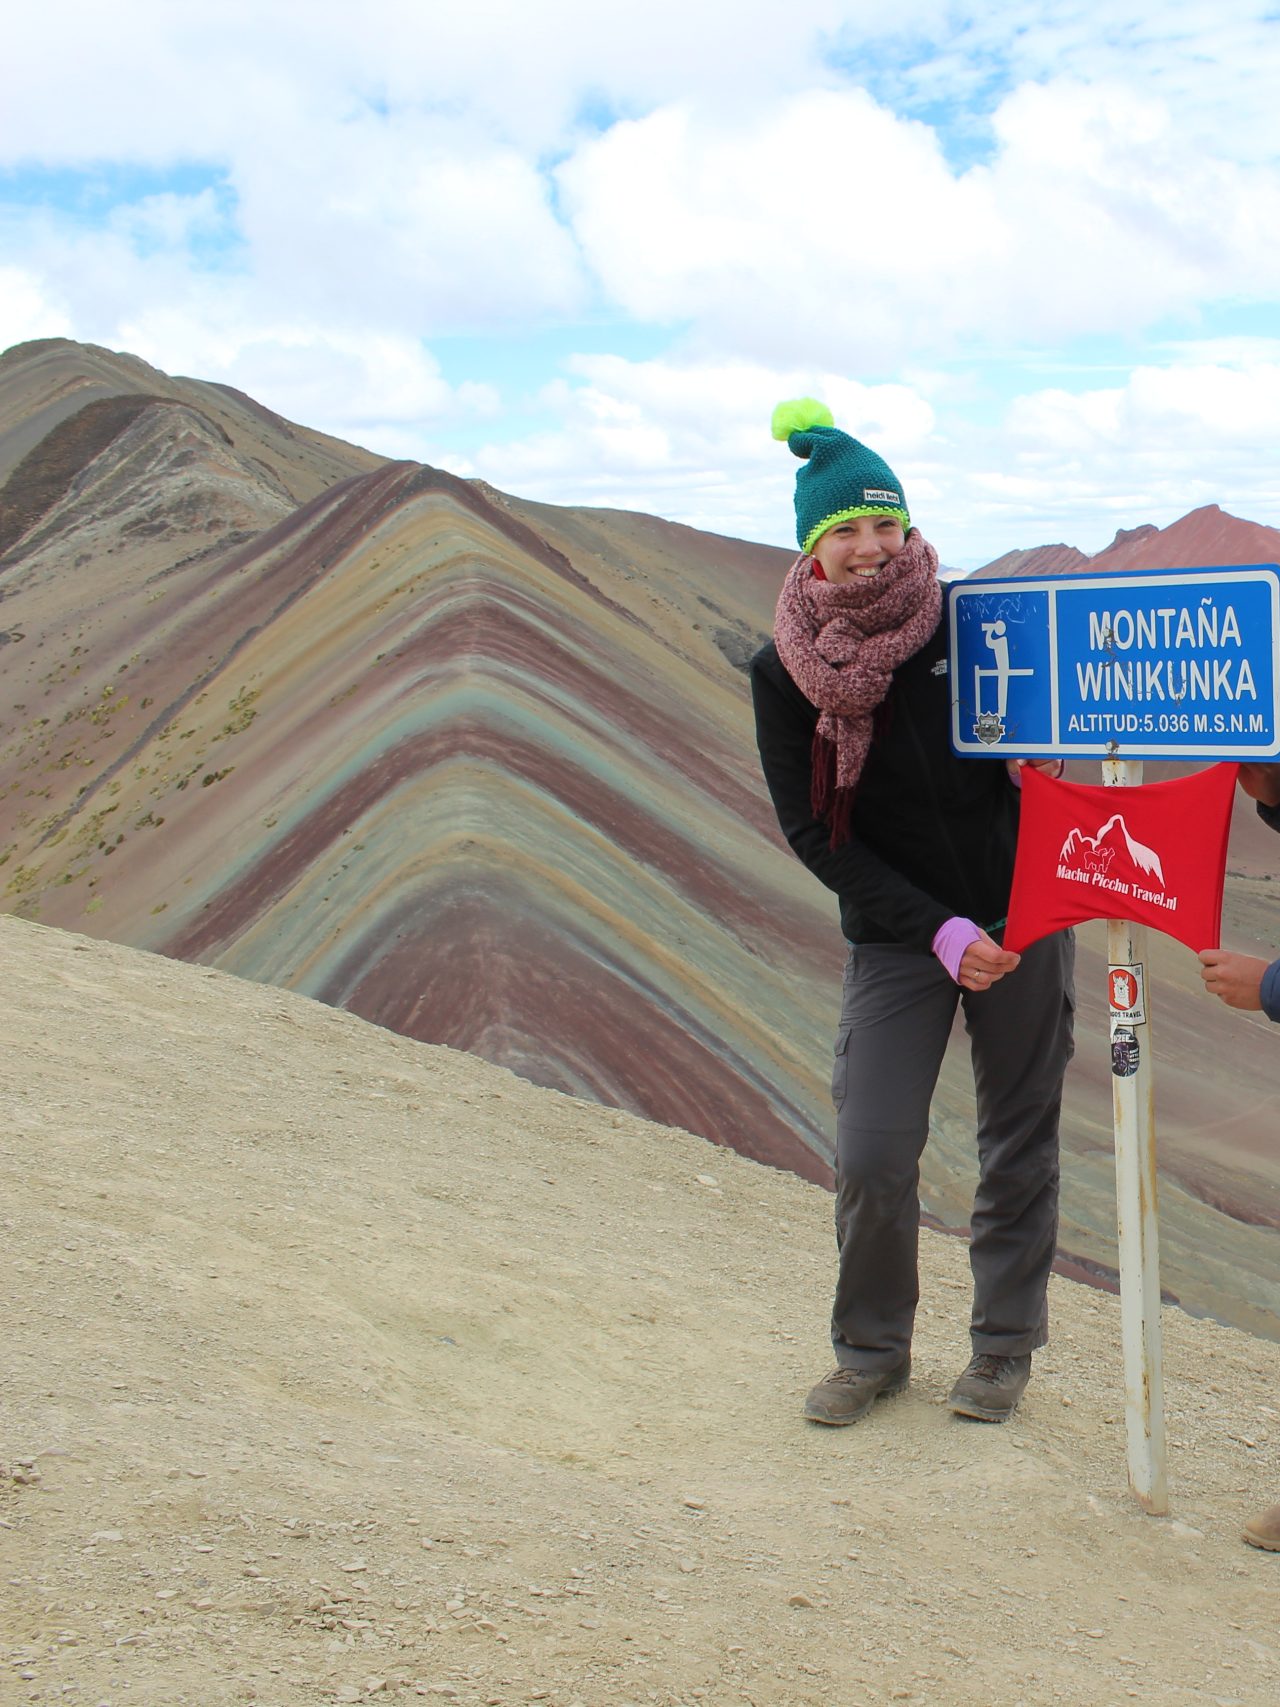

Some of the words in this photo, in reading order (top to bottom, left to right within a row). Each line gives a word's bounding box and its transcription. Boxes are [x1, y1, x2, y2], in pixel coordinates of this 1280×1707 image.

[1089, 597, 1242, 650] MONTAÑA
[1077, 659, 1257, 701] WINIKUNKA
[1194, 714, 1269, 733] M.S.N.M.
[1056, 865, 1089, 882] Machu
[1092, 873, 1128, 892] Picchu
[1132, 883, 1176, 910] Travel.nl
